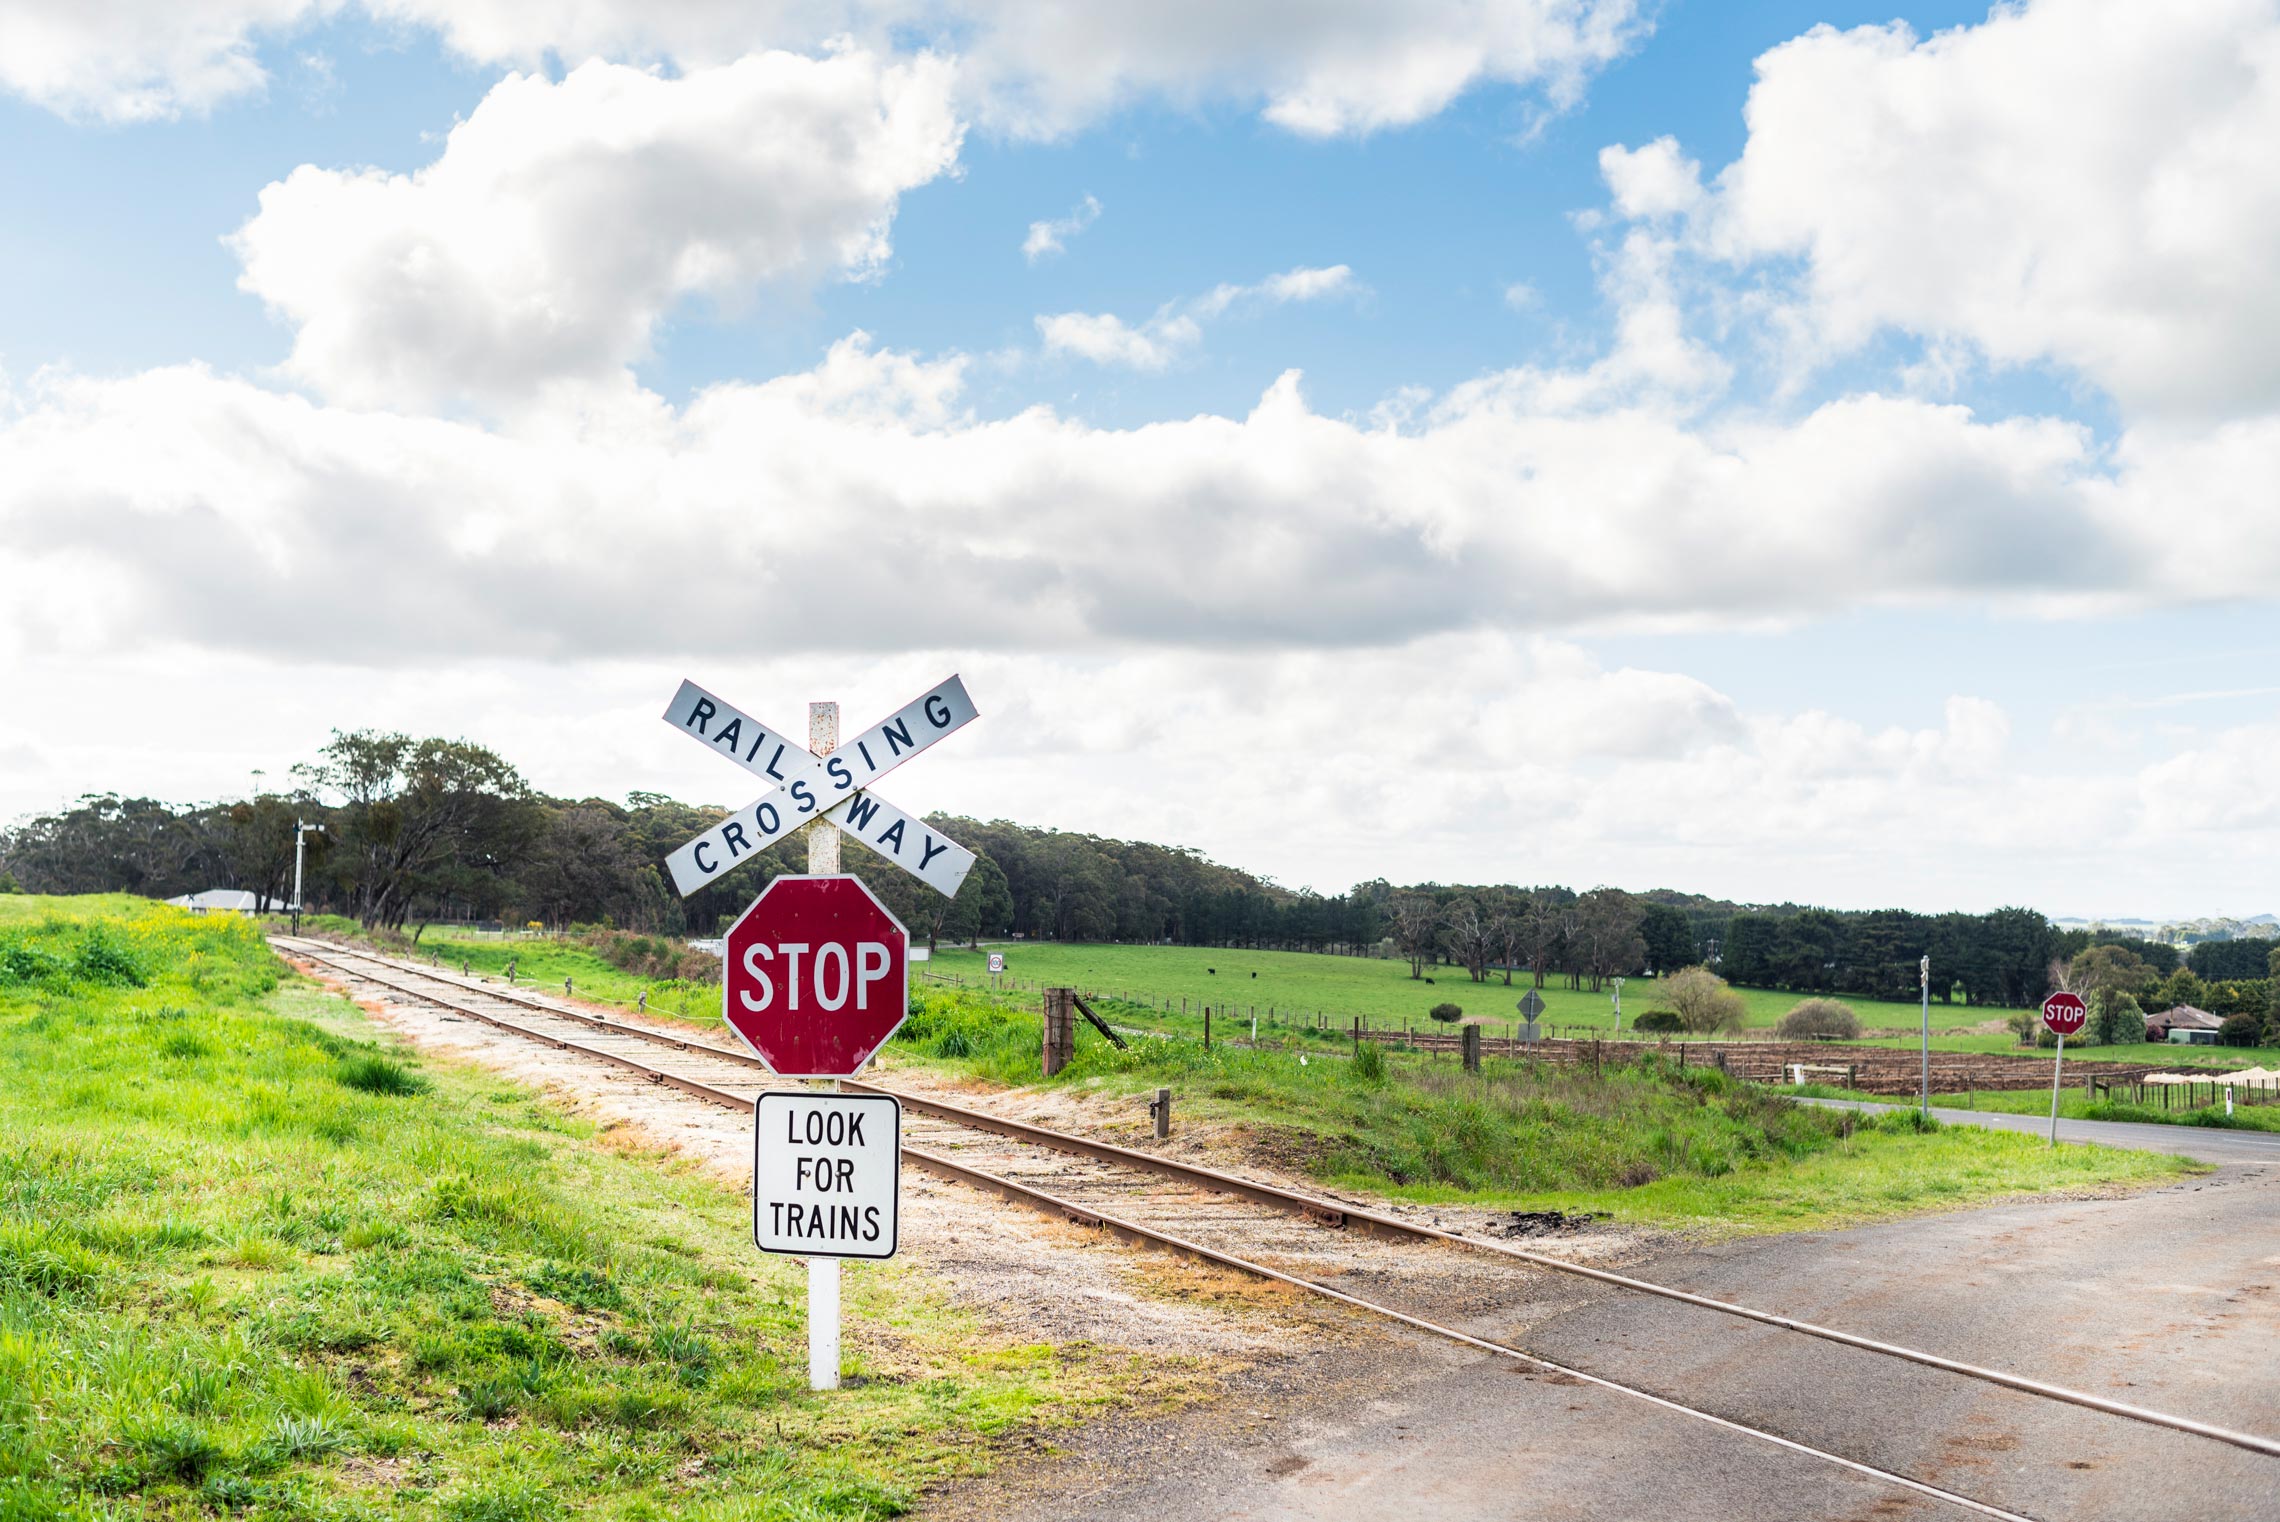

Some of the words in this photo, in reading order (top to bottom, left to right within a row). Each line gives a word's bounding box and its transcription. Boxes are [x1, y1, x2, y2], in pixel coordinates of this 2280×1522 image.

[693, 695, 952, 874] CROSSING
[740, 941, 892, 1012] STOP
[2045, 1004, 2084, 1023] STOP
[788, 1110, 866, 1147] LOOK
[796, 1157, 854, 1193] FOR
[770, 1202, 880, 1242] TRAINS
